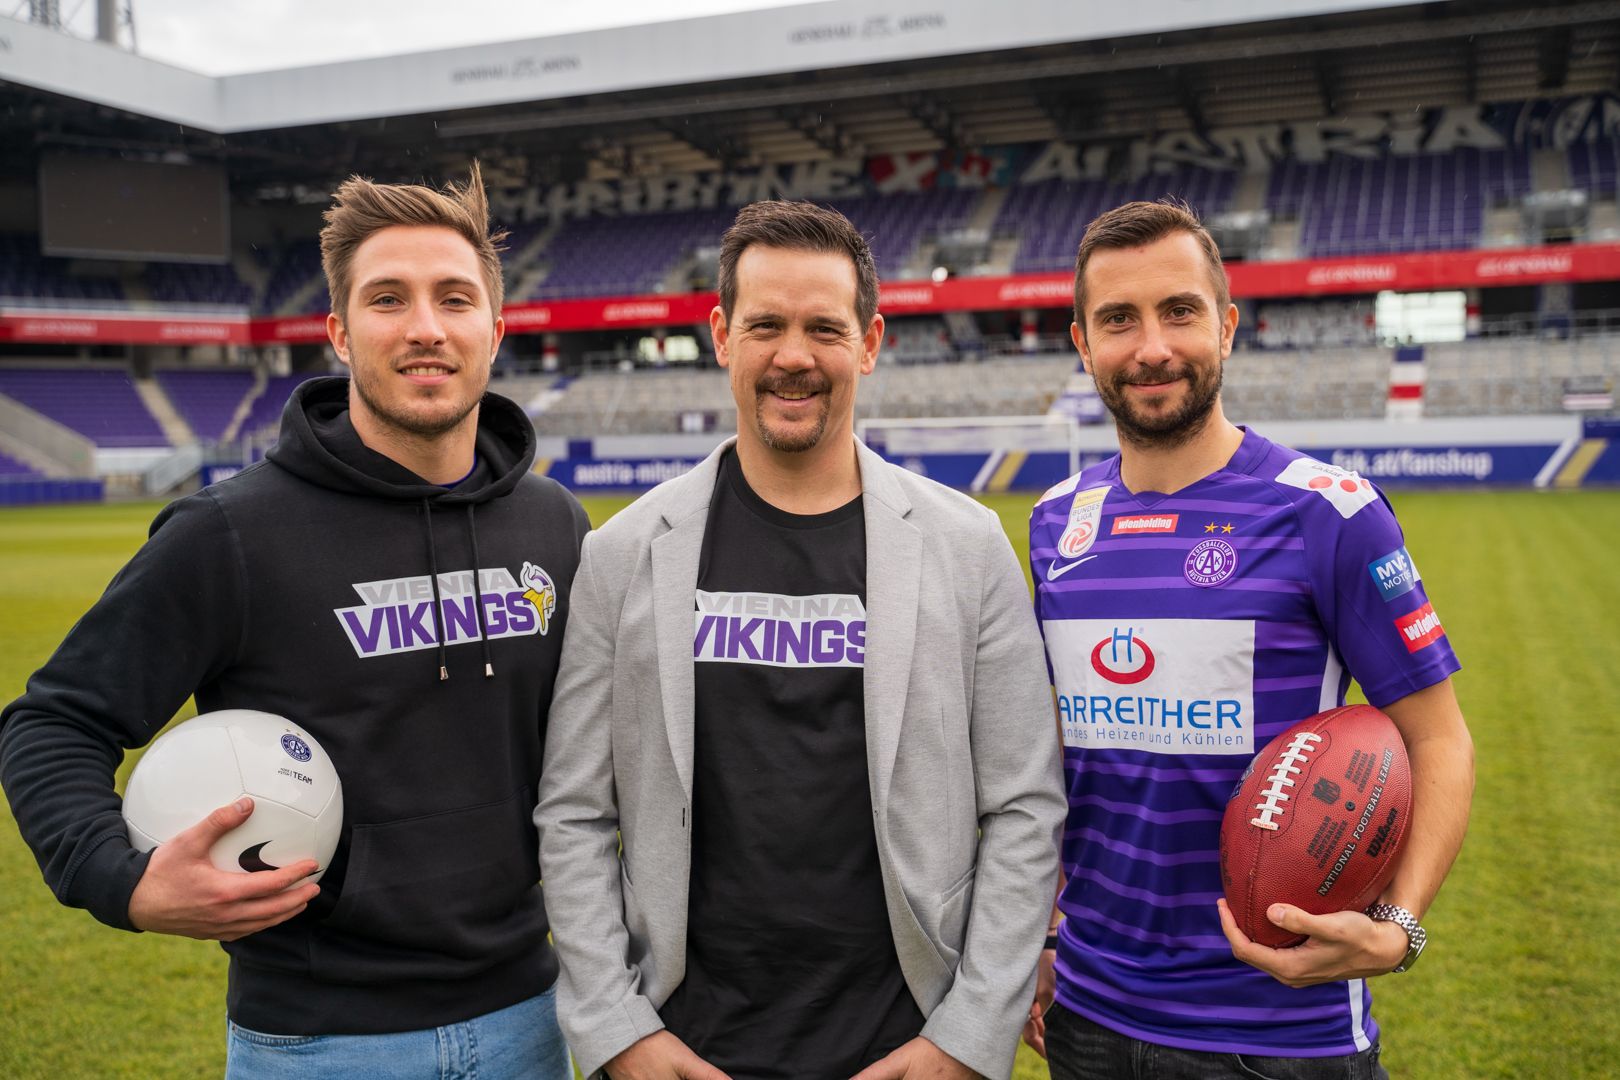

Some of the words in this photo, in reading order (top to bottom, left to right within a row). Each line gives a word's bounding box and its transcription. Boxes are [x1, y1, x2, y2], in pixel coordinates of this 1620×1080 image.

[361, 571, 515, 604] VIENNA
[342, 591, 536, 654] VIKINGS
[701, 595, 863, 619] VIENNA
[1058, 695, 1243, 729] ARREITHER
[1096, 727, 1145, 741] Heizen
[1149, 732, 1171, 745] und
[1182, 732, 1244, 746] Kühlen
[293, 771, 313, 785] TEAM
[1317, 842, 1356, 896] NATIONAL
[1353, 784, 1384, 840] FOOTBALL
[1378, 747, 1394, 785] LEAGUE
